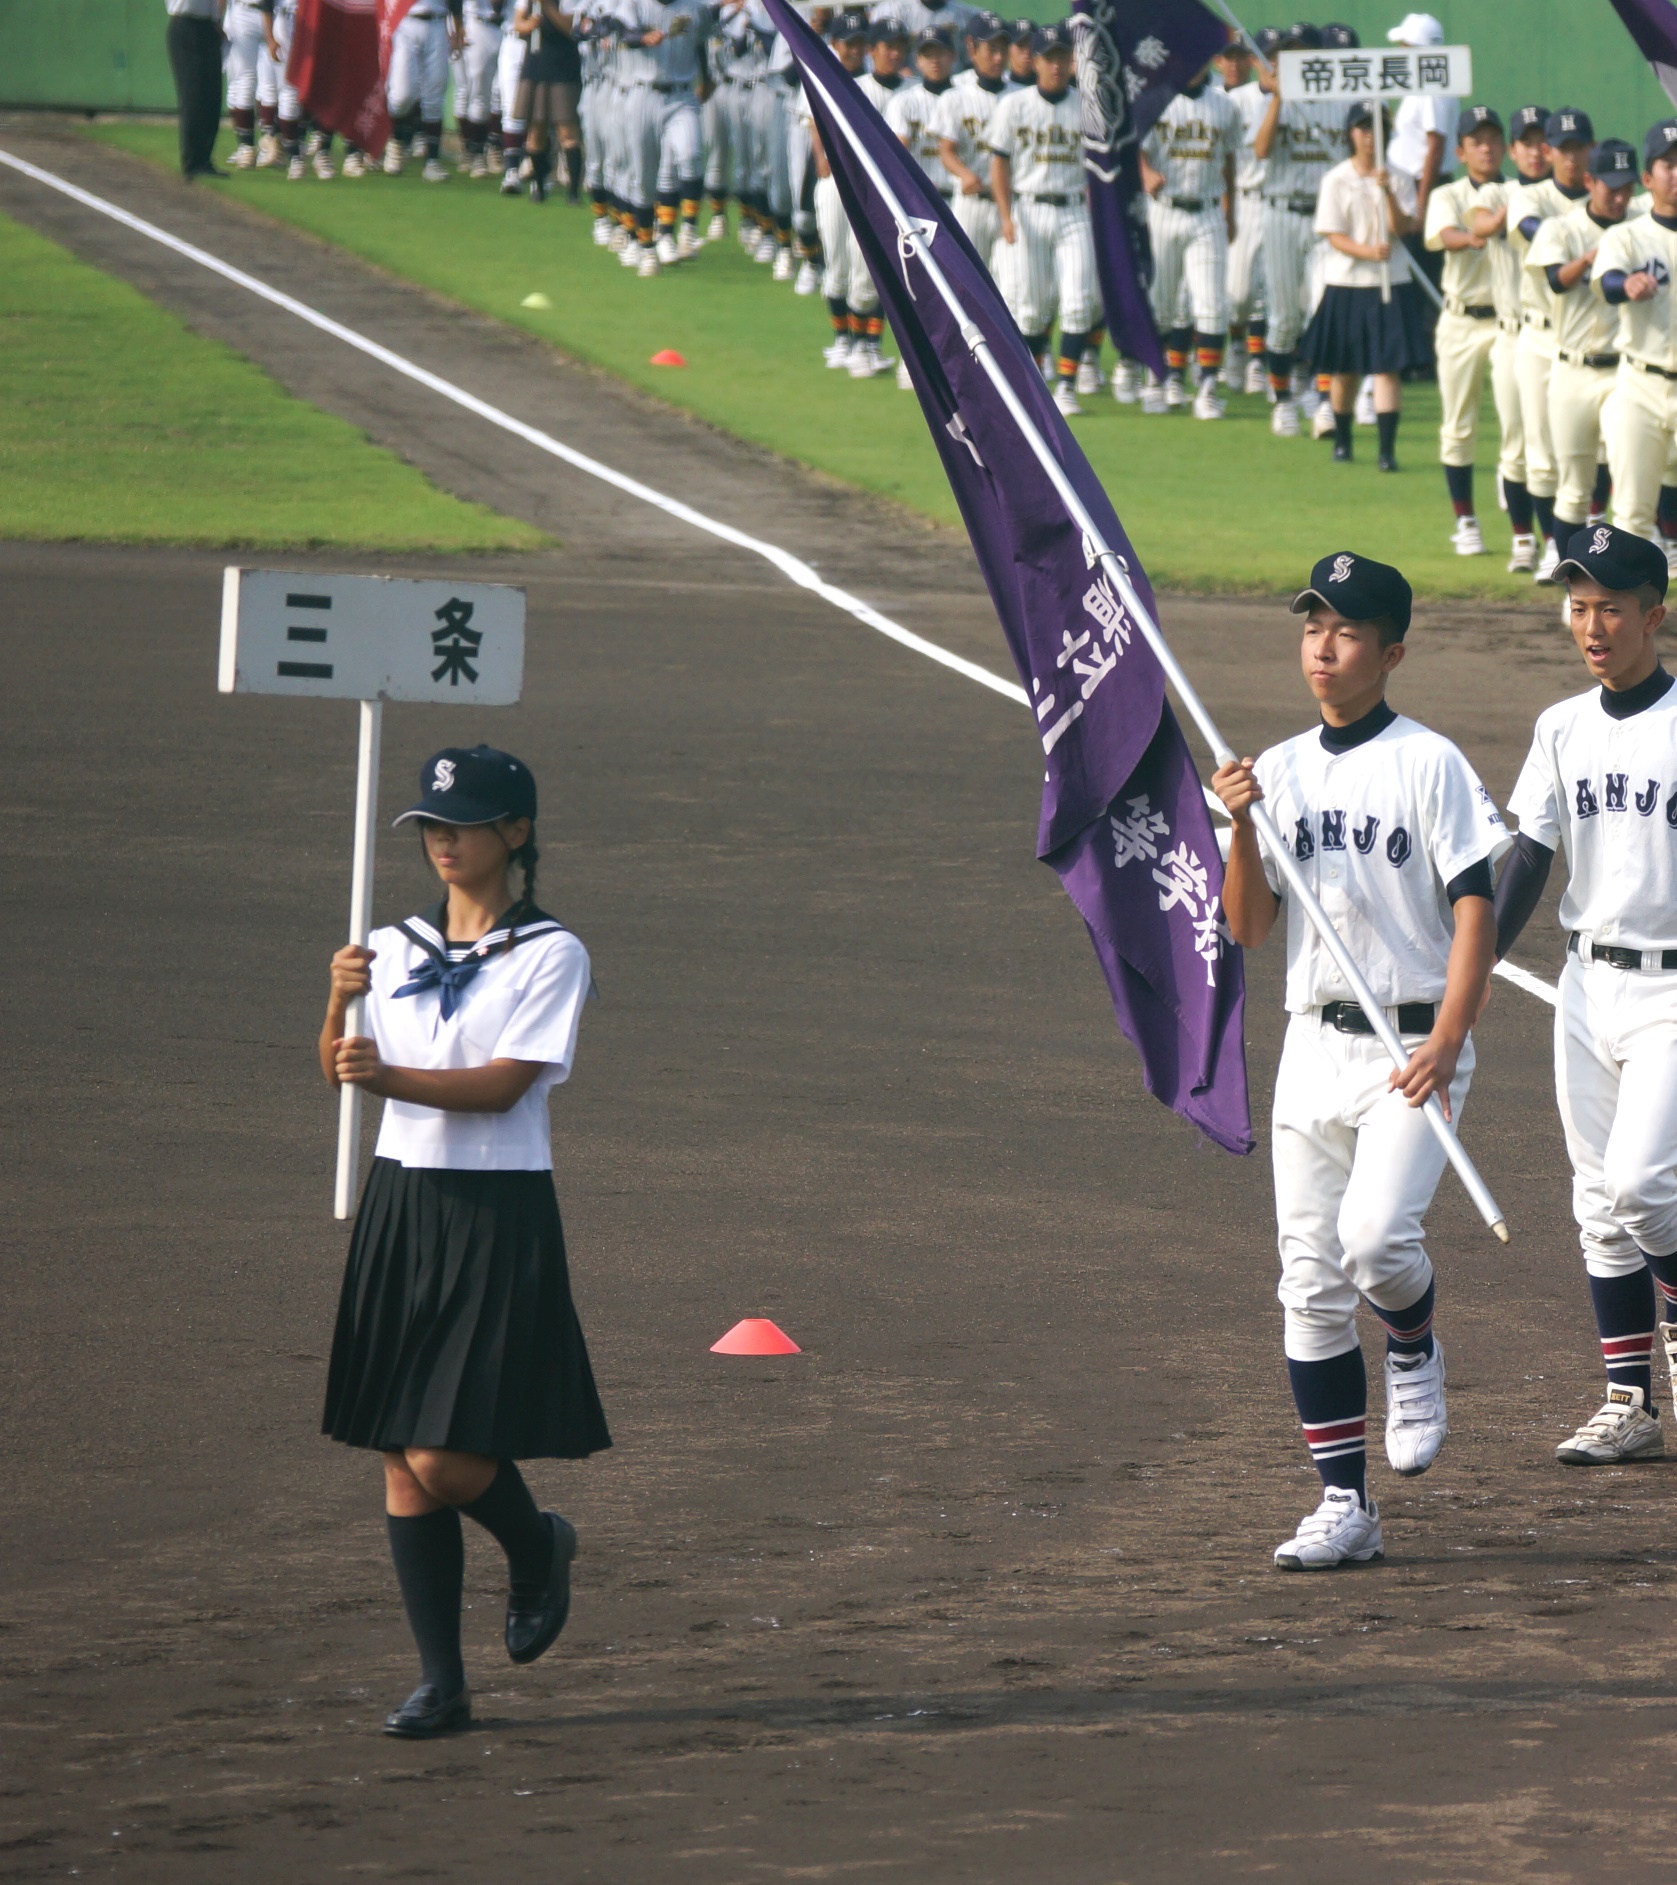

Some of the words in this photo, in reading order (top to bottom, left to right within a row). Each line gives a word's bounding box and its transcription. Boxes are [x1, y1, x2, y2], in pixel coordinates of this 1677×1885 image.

[1301, 55, 1450, 93] 帝京長岡
[1561, 115, 1576, 131] H
[1614, 152, 1629, 169] H
[1588, 527, 1613, 554] S
[1328, 554, 1354, 583] S
[277, 593, 483, 686] 三条
[431, 759, 457, 792] S
[1284, 809, 1413, 868] ANJO
[1610, 1394, 1631, 1403] ZETT
